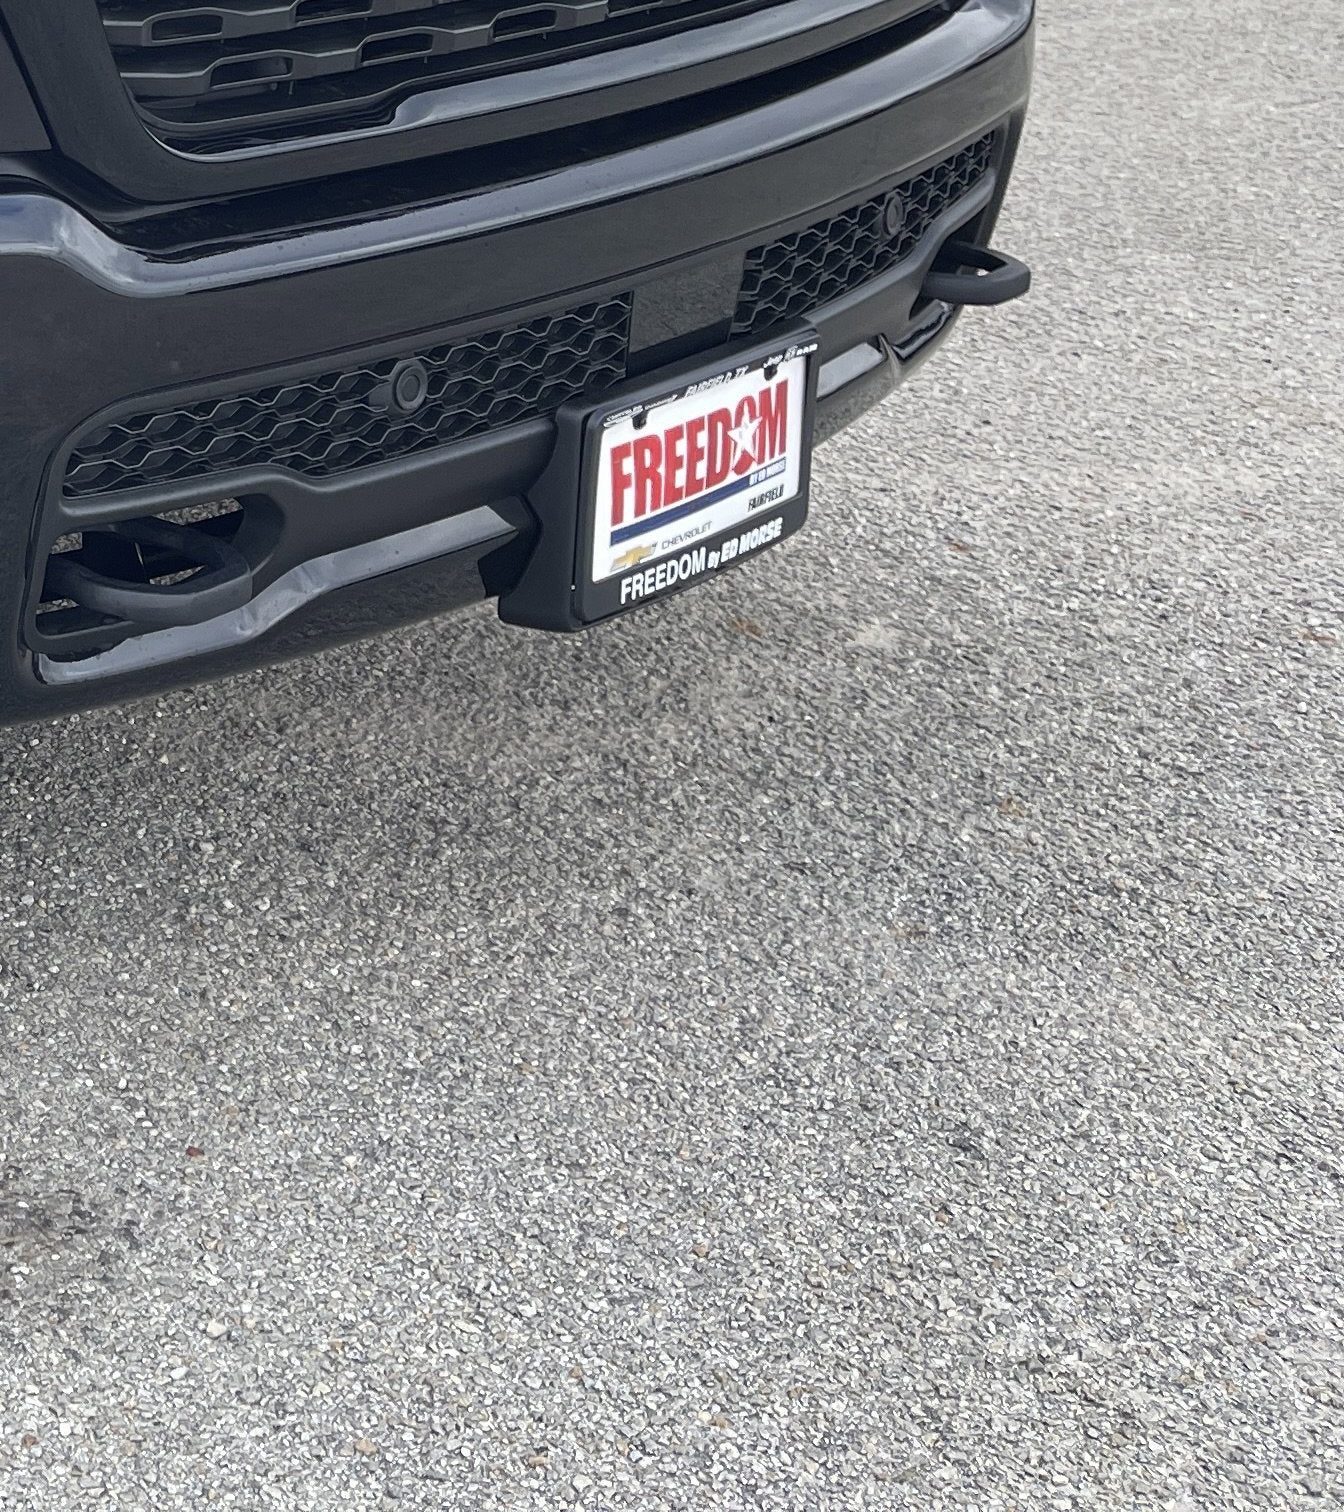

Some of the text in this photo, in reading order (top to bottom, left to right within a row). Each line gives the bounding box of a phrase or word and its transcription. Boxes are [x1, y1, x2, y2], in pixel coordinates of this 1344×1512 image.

[610, 379, 788, 526] FREEDOM
[620, 546, 706, 604] FREEDOM
[721, 538, 738, 562] ED
[739, 517, 783, 554] MORSE
[662, 521, 712, 550] CHEVROLET
